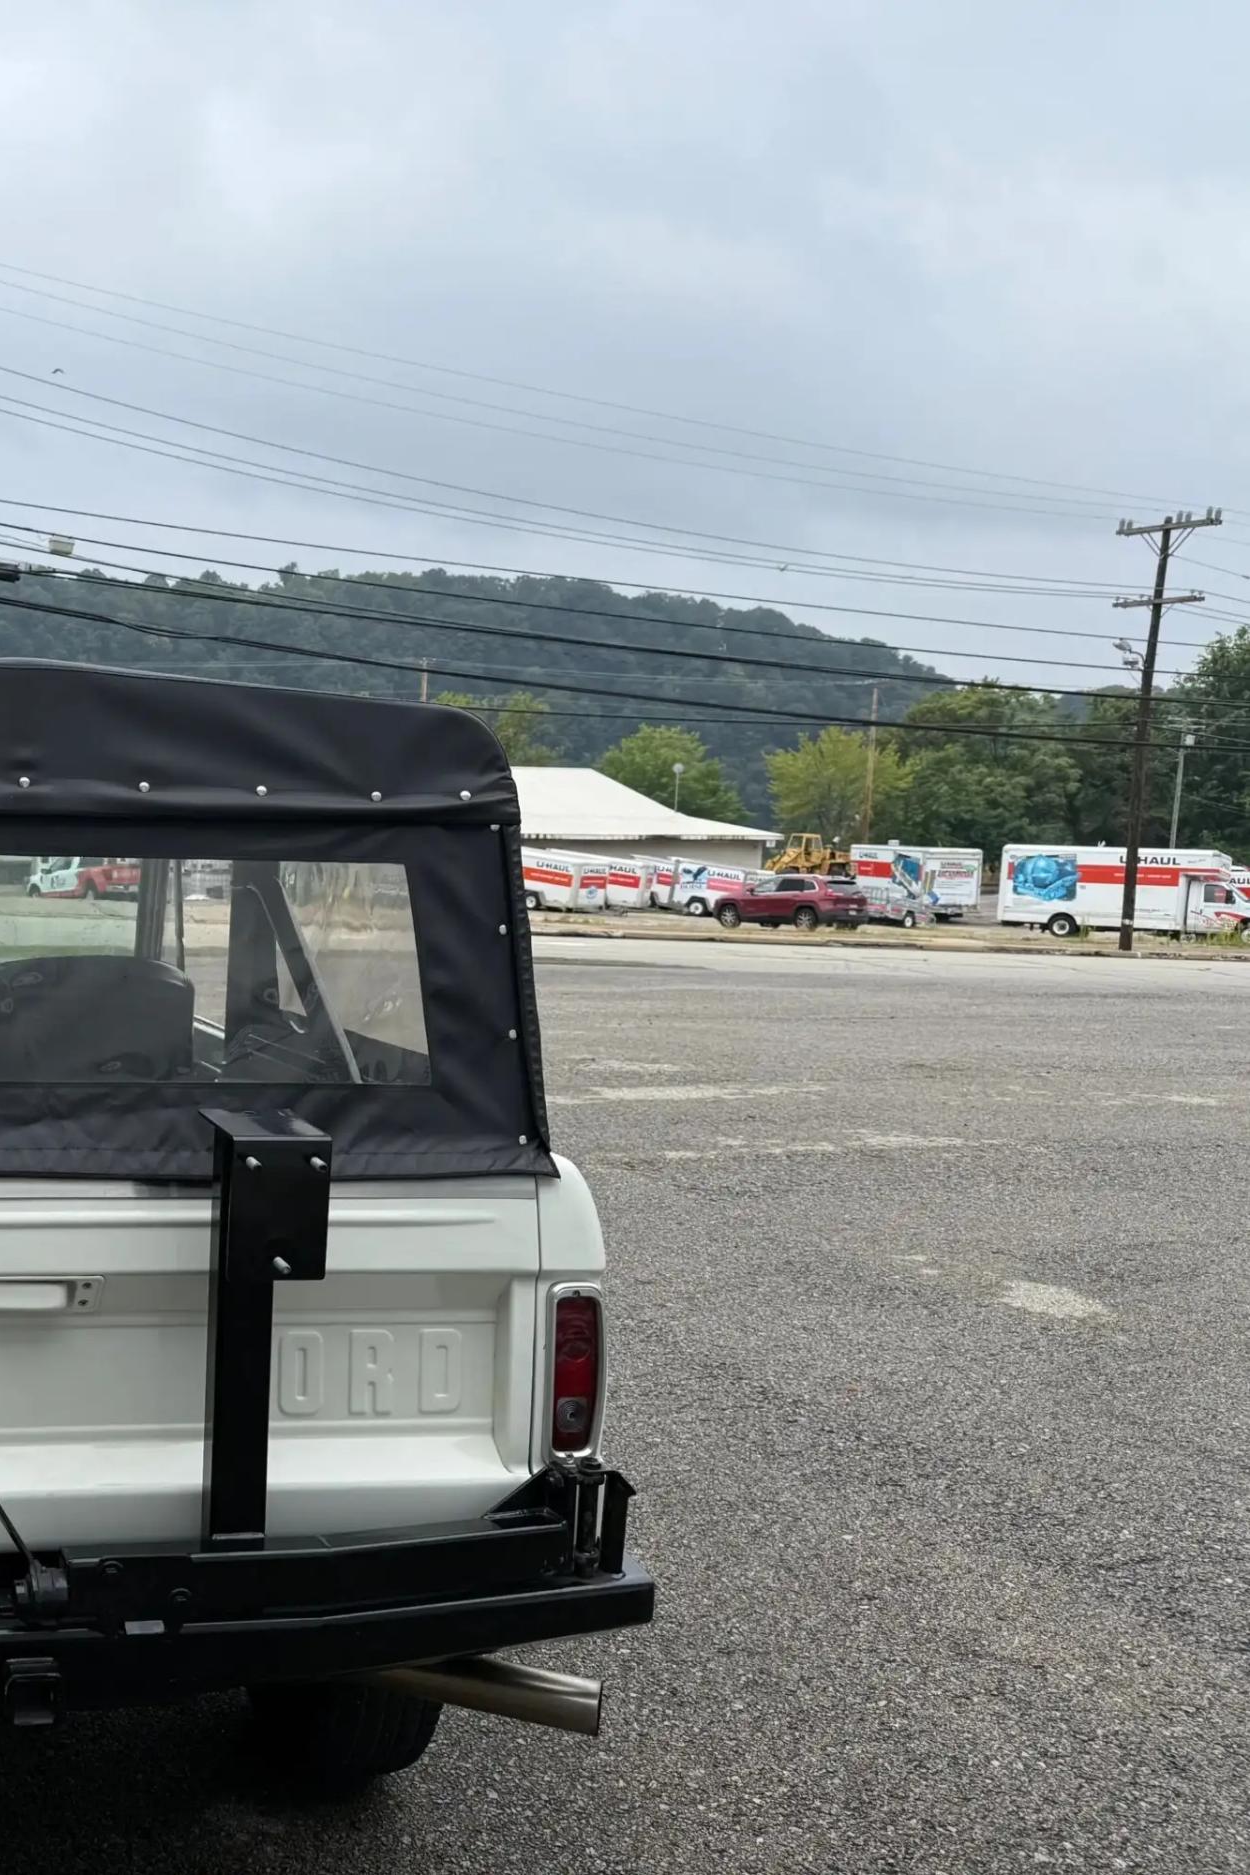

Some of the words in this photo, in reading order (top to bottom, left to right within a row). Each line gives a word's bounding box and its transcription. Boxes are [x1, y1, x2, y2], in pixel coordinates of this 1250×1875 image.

[1120, 856, 1181, 865] UHAUL
[609, 865, 637, 874] HAUL
[278, 1328, 463, 1416] ORD
